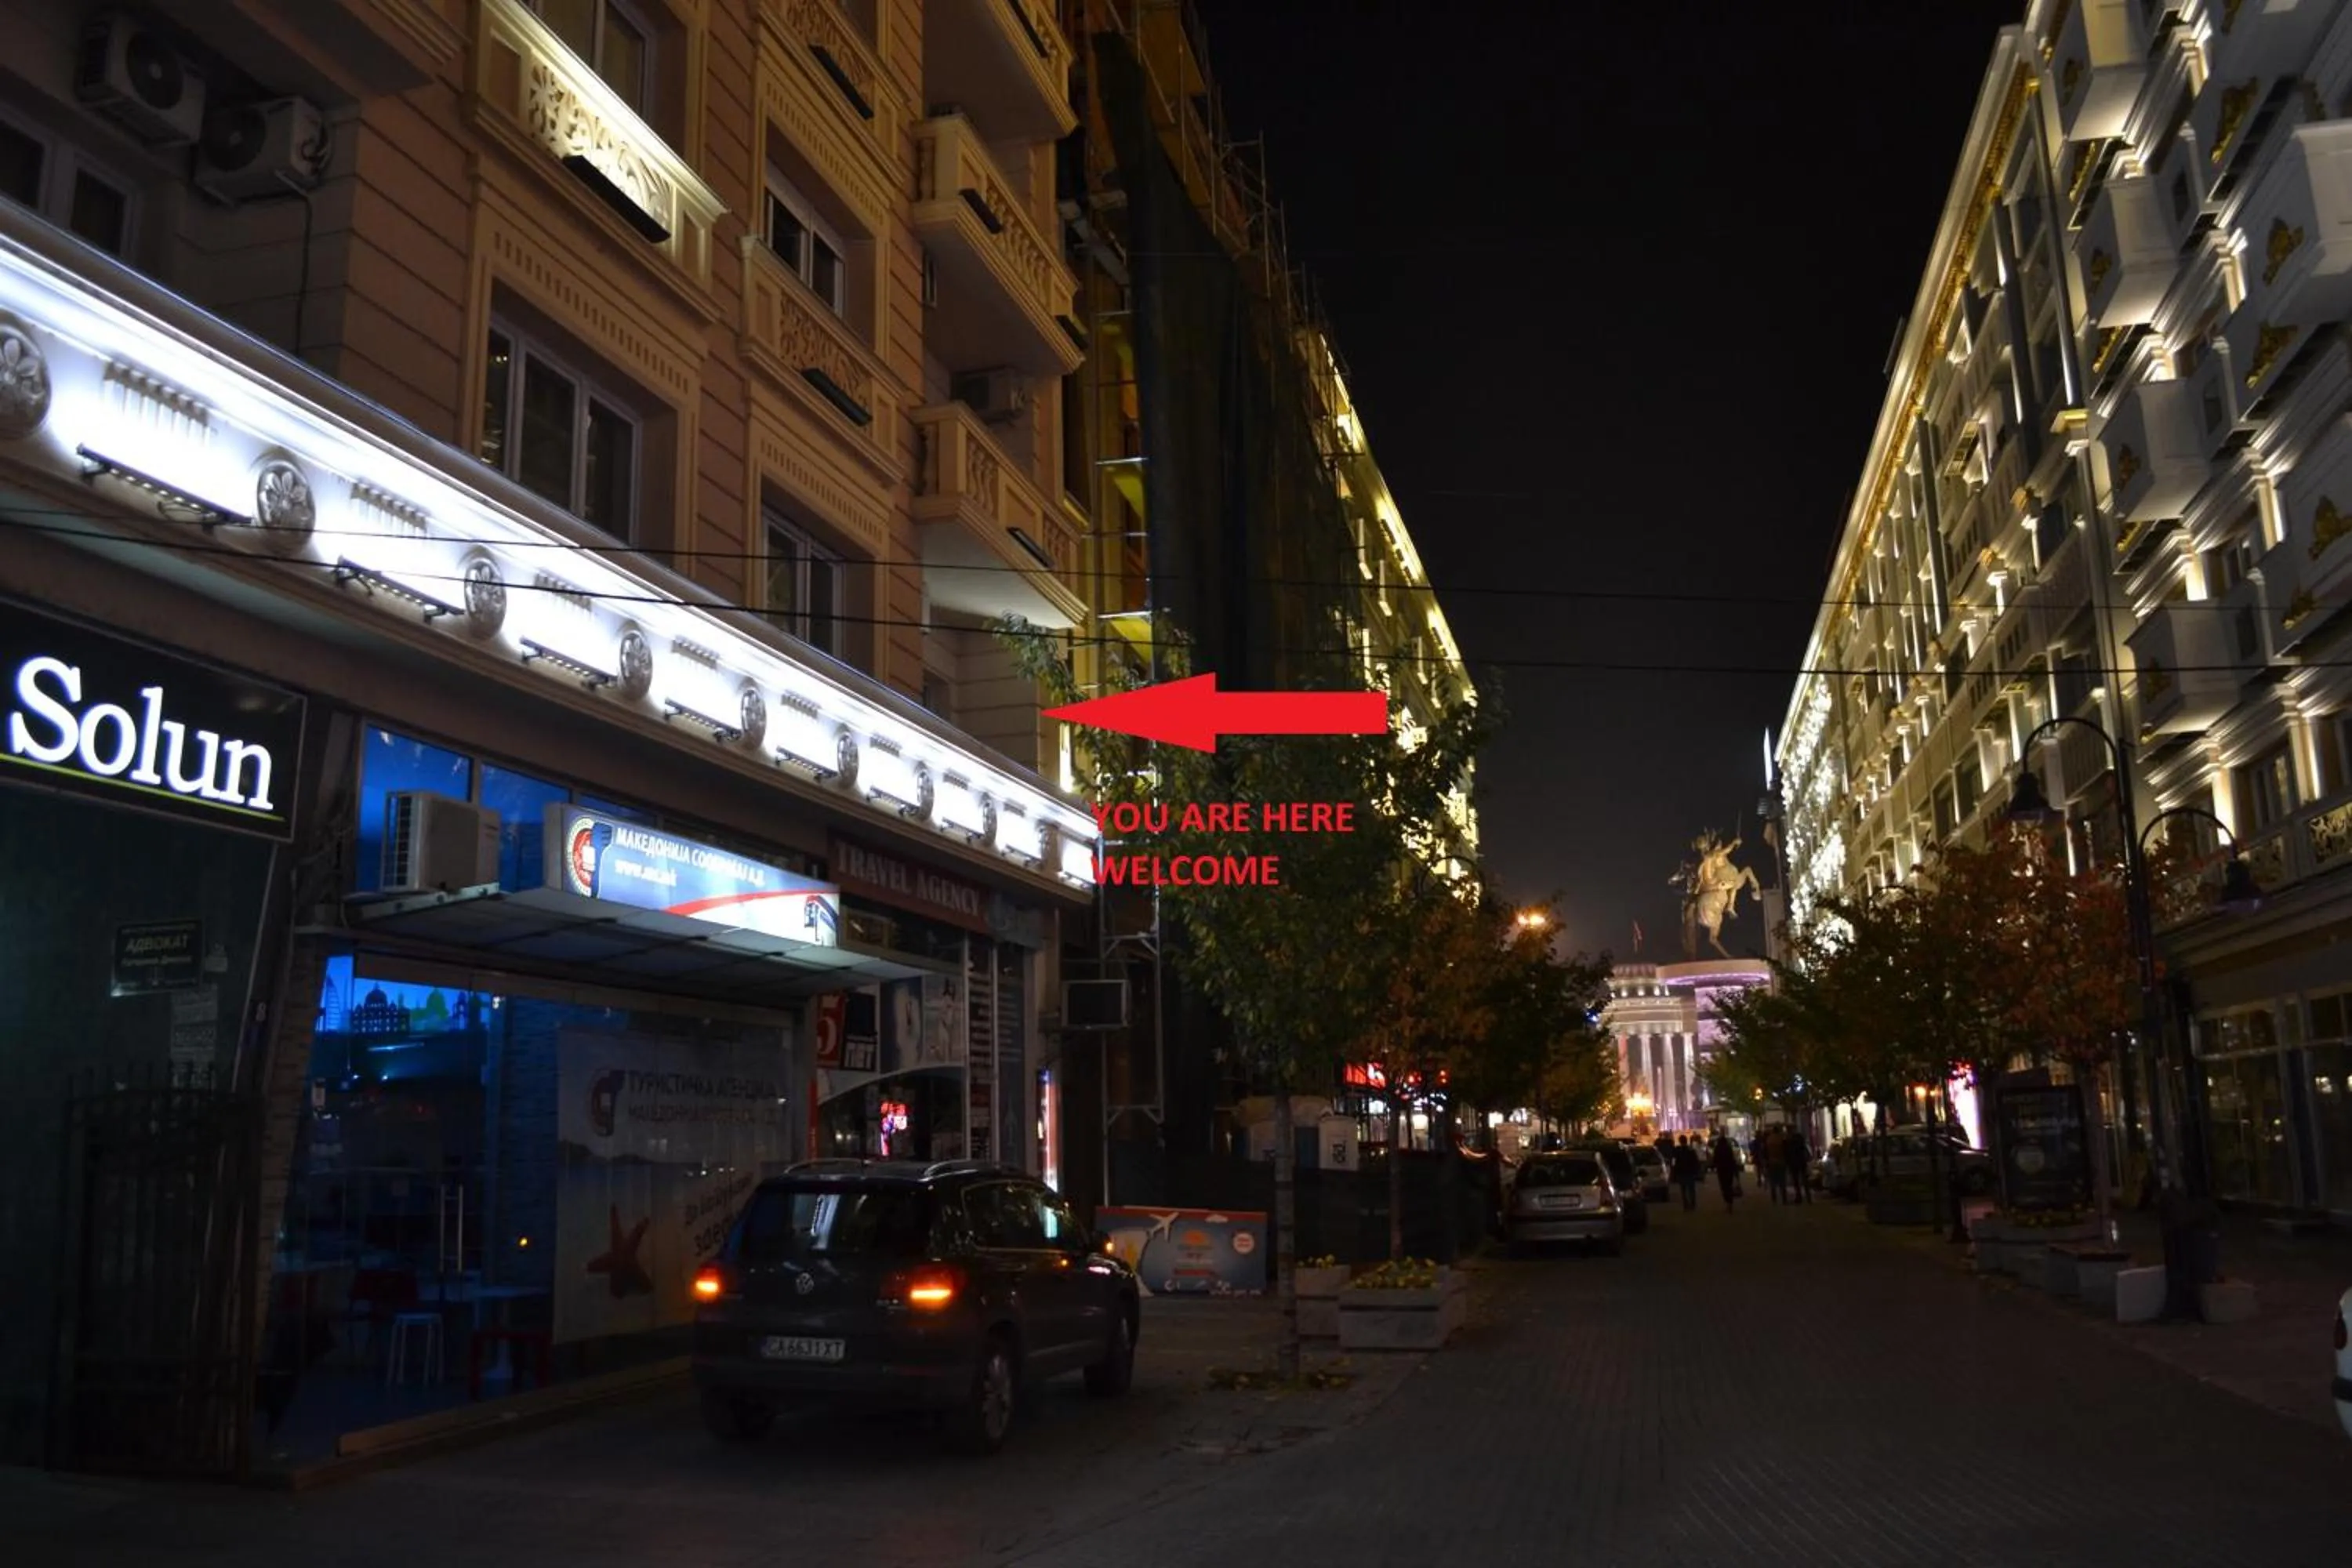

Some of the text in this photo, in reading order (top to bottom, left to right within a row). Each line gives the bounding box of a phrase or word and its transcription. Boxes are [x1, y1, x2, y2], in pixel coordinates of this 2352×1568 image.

[9, 656, 274, 810] Solun
[835, 841, 911, 899] TRAVEL
[916, 869, 980, 917] AGENCY
